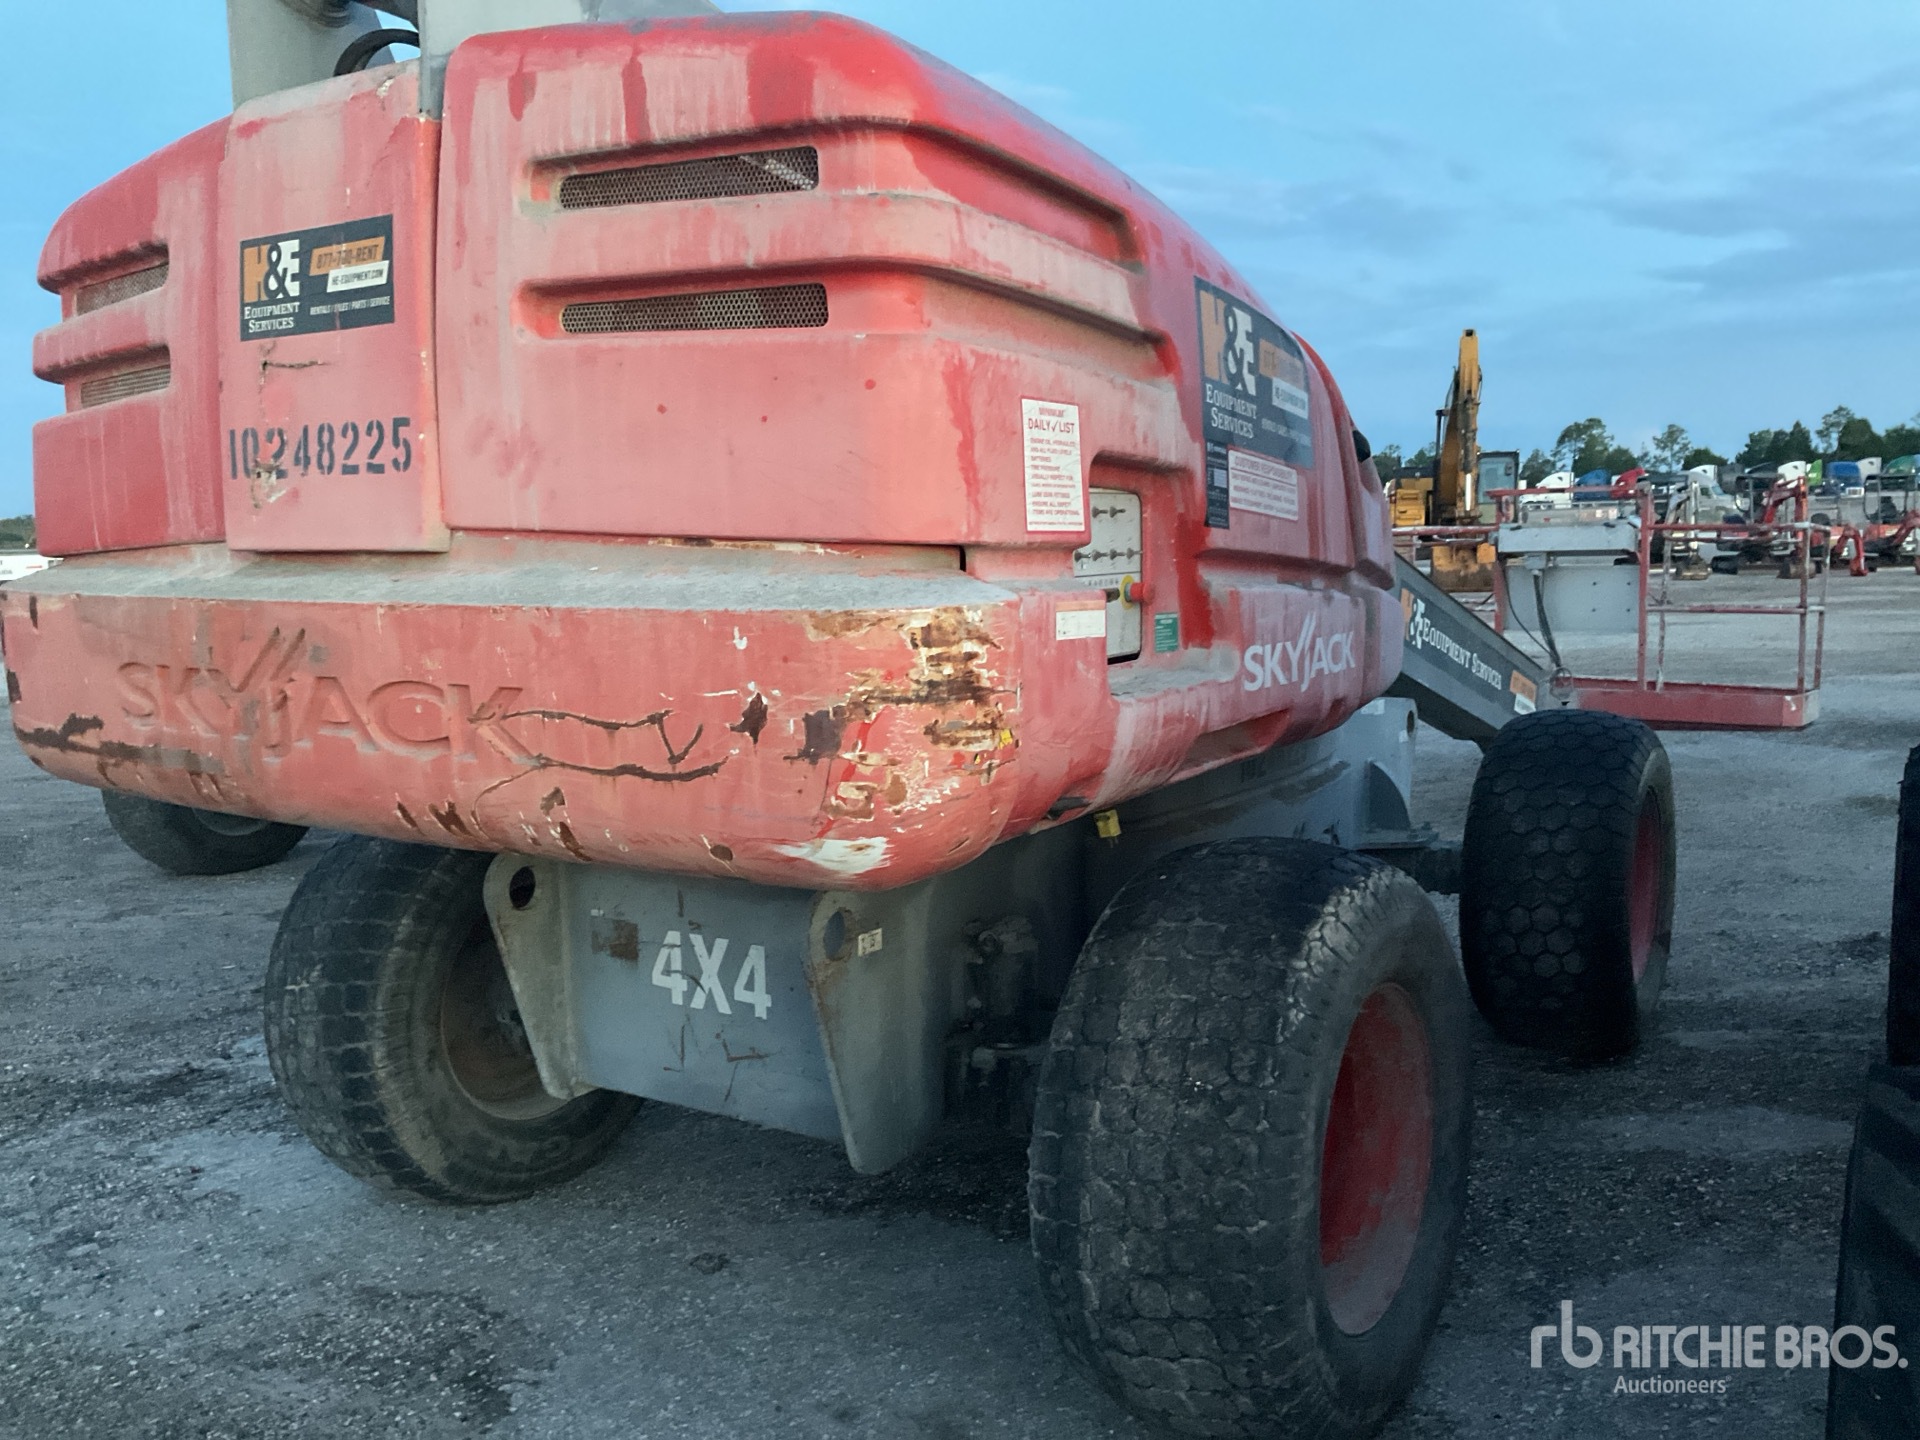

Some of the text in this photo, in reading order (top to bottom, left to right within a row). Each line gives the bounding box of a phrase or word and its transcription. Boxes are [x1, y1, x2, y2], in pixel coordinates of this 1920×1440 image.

[243, 238, 300, 304] H&E
[244, 301, 300, 319] EQUIPMENT
[249, 317, 294, 334] SERVICES
[1200, 289, 1257, 397] H&E
[1028, 417, 1075, 434] DAILY LIST
[1205, 382, 1257, 419] EQUIPMENT
[1211, 406, 1254, 439] SERVICES
[229, 416, 412, 480] 10248225
[1243, 612, 1356, 693] SKYJACK
[1422, 619, 1471, 669] EQUIPMENT
[1472, 652, 1502, 690] SERVICES
[116, 626, 541, 767] SKYJACK
[651, 930, 772, 1020] 4X4
